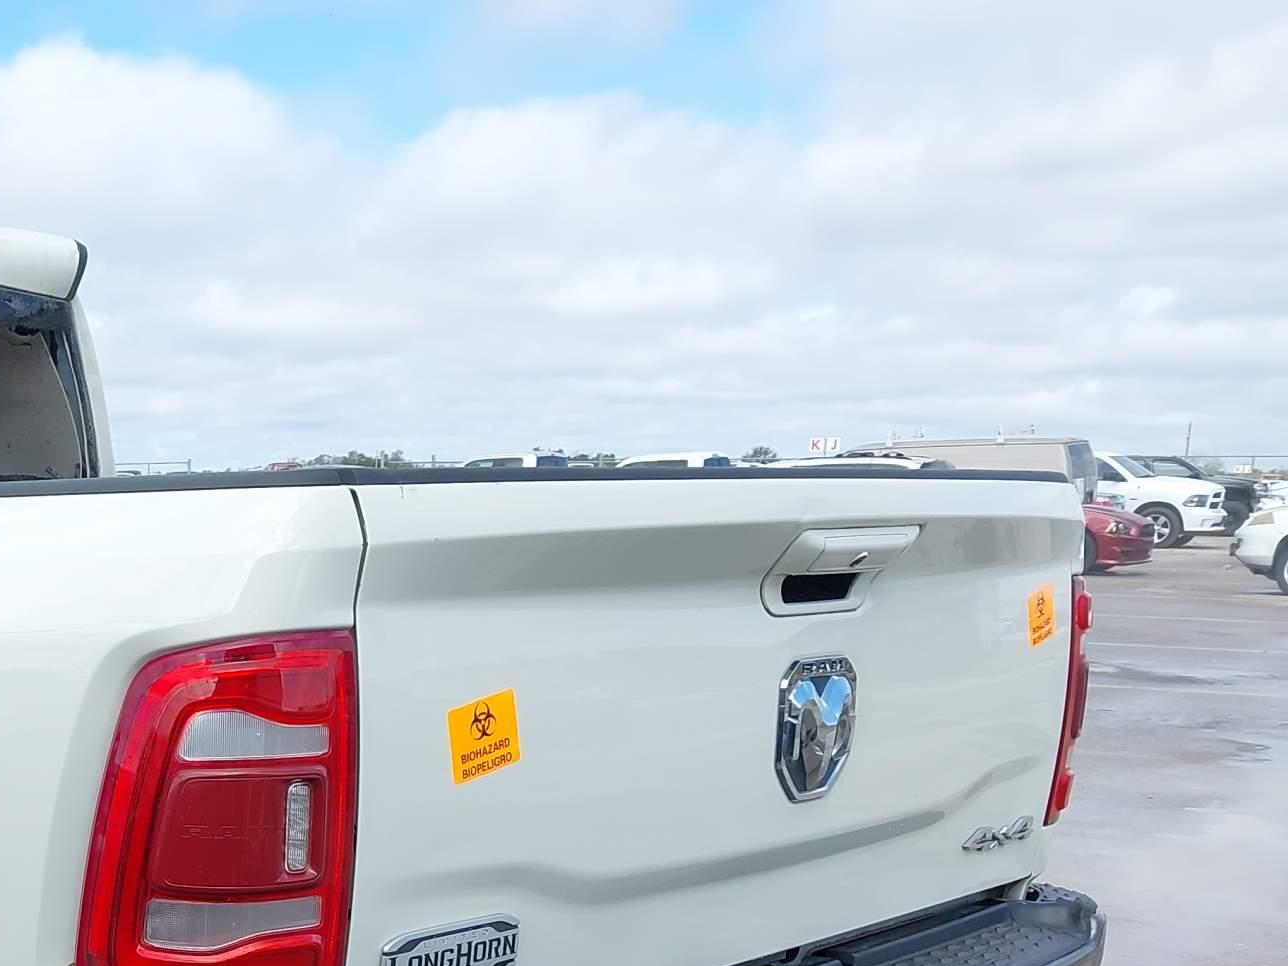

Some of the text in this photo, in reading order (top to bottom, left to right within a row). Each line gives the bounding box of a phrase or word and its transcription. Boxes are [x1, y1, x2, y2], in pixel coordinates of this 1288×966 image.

[811, 439, 838, 451] K J
[802, 659, 845, 675] RAM
[460, 737, 510, 765] BIOHAZARD
[461, 751, 513, 779] BIOPELIGRO
[423, 929, 489, 948] LIMITED
